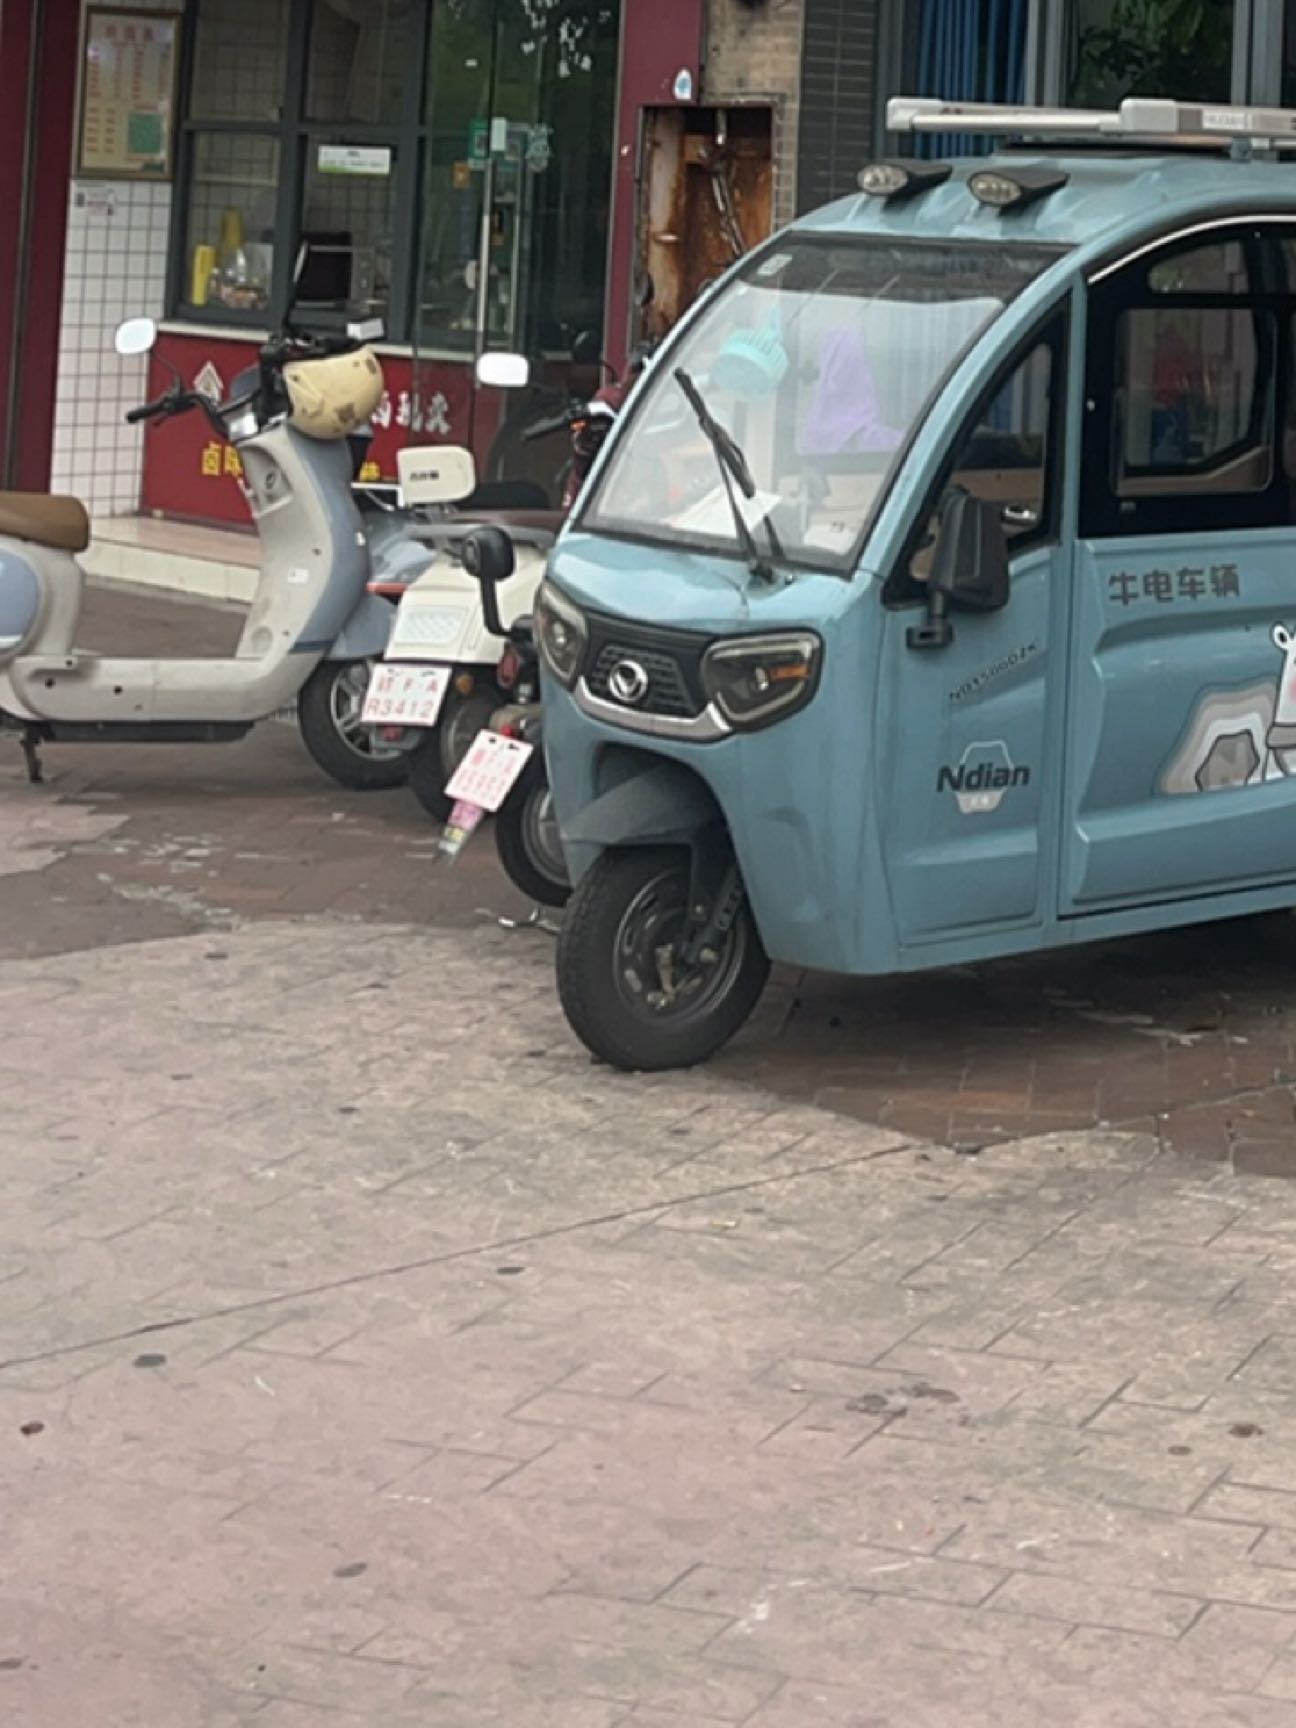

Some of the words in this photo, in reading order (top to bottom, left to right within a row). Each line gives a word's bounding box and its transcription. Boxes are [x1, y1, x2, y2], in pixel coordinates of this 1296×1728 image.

[1108, 564, 1240, 606] 牛电车辆
[937, 763, 1030, 792] Ndian
